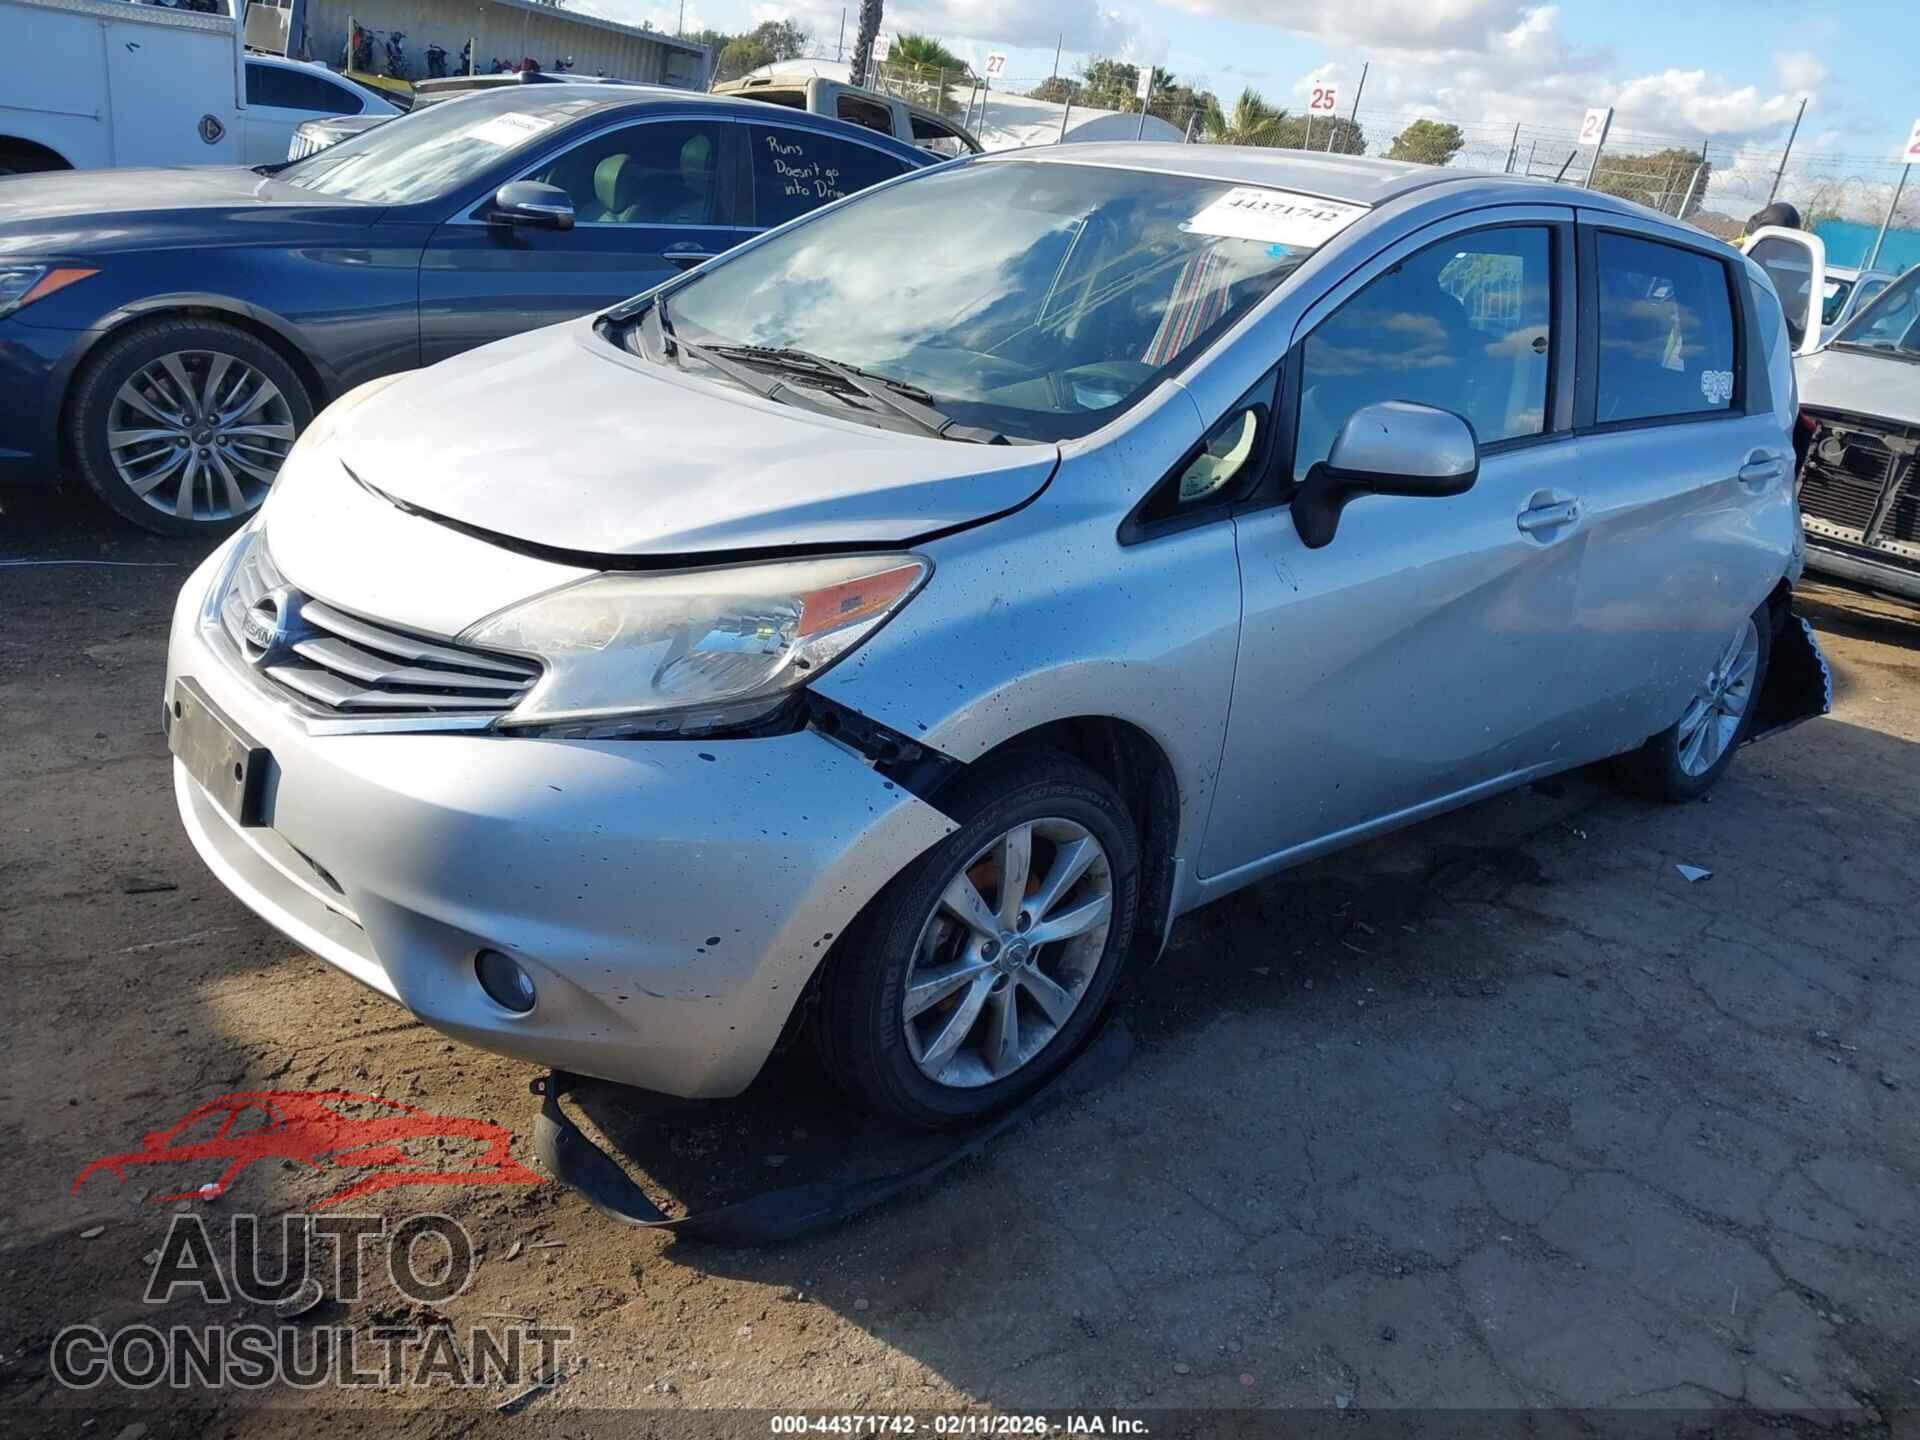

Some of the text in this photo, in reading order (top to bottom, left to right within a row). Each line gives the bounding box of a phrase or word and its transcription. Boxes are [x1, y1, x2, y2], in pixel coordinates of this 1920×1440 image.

[987, 56, 1005, 72] 27
[1311, 88, 1335, 110] 25
[766, 136, 803, 156] Runs
[825, 168, 840, 186] go
[785, 179, 811, 196] into
[1228, 199, 1338, 222] 44371742
